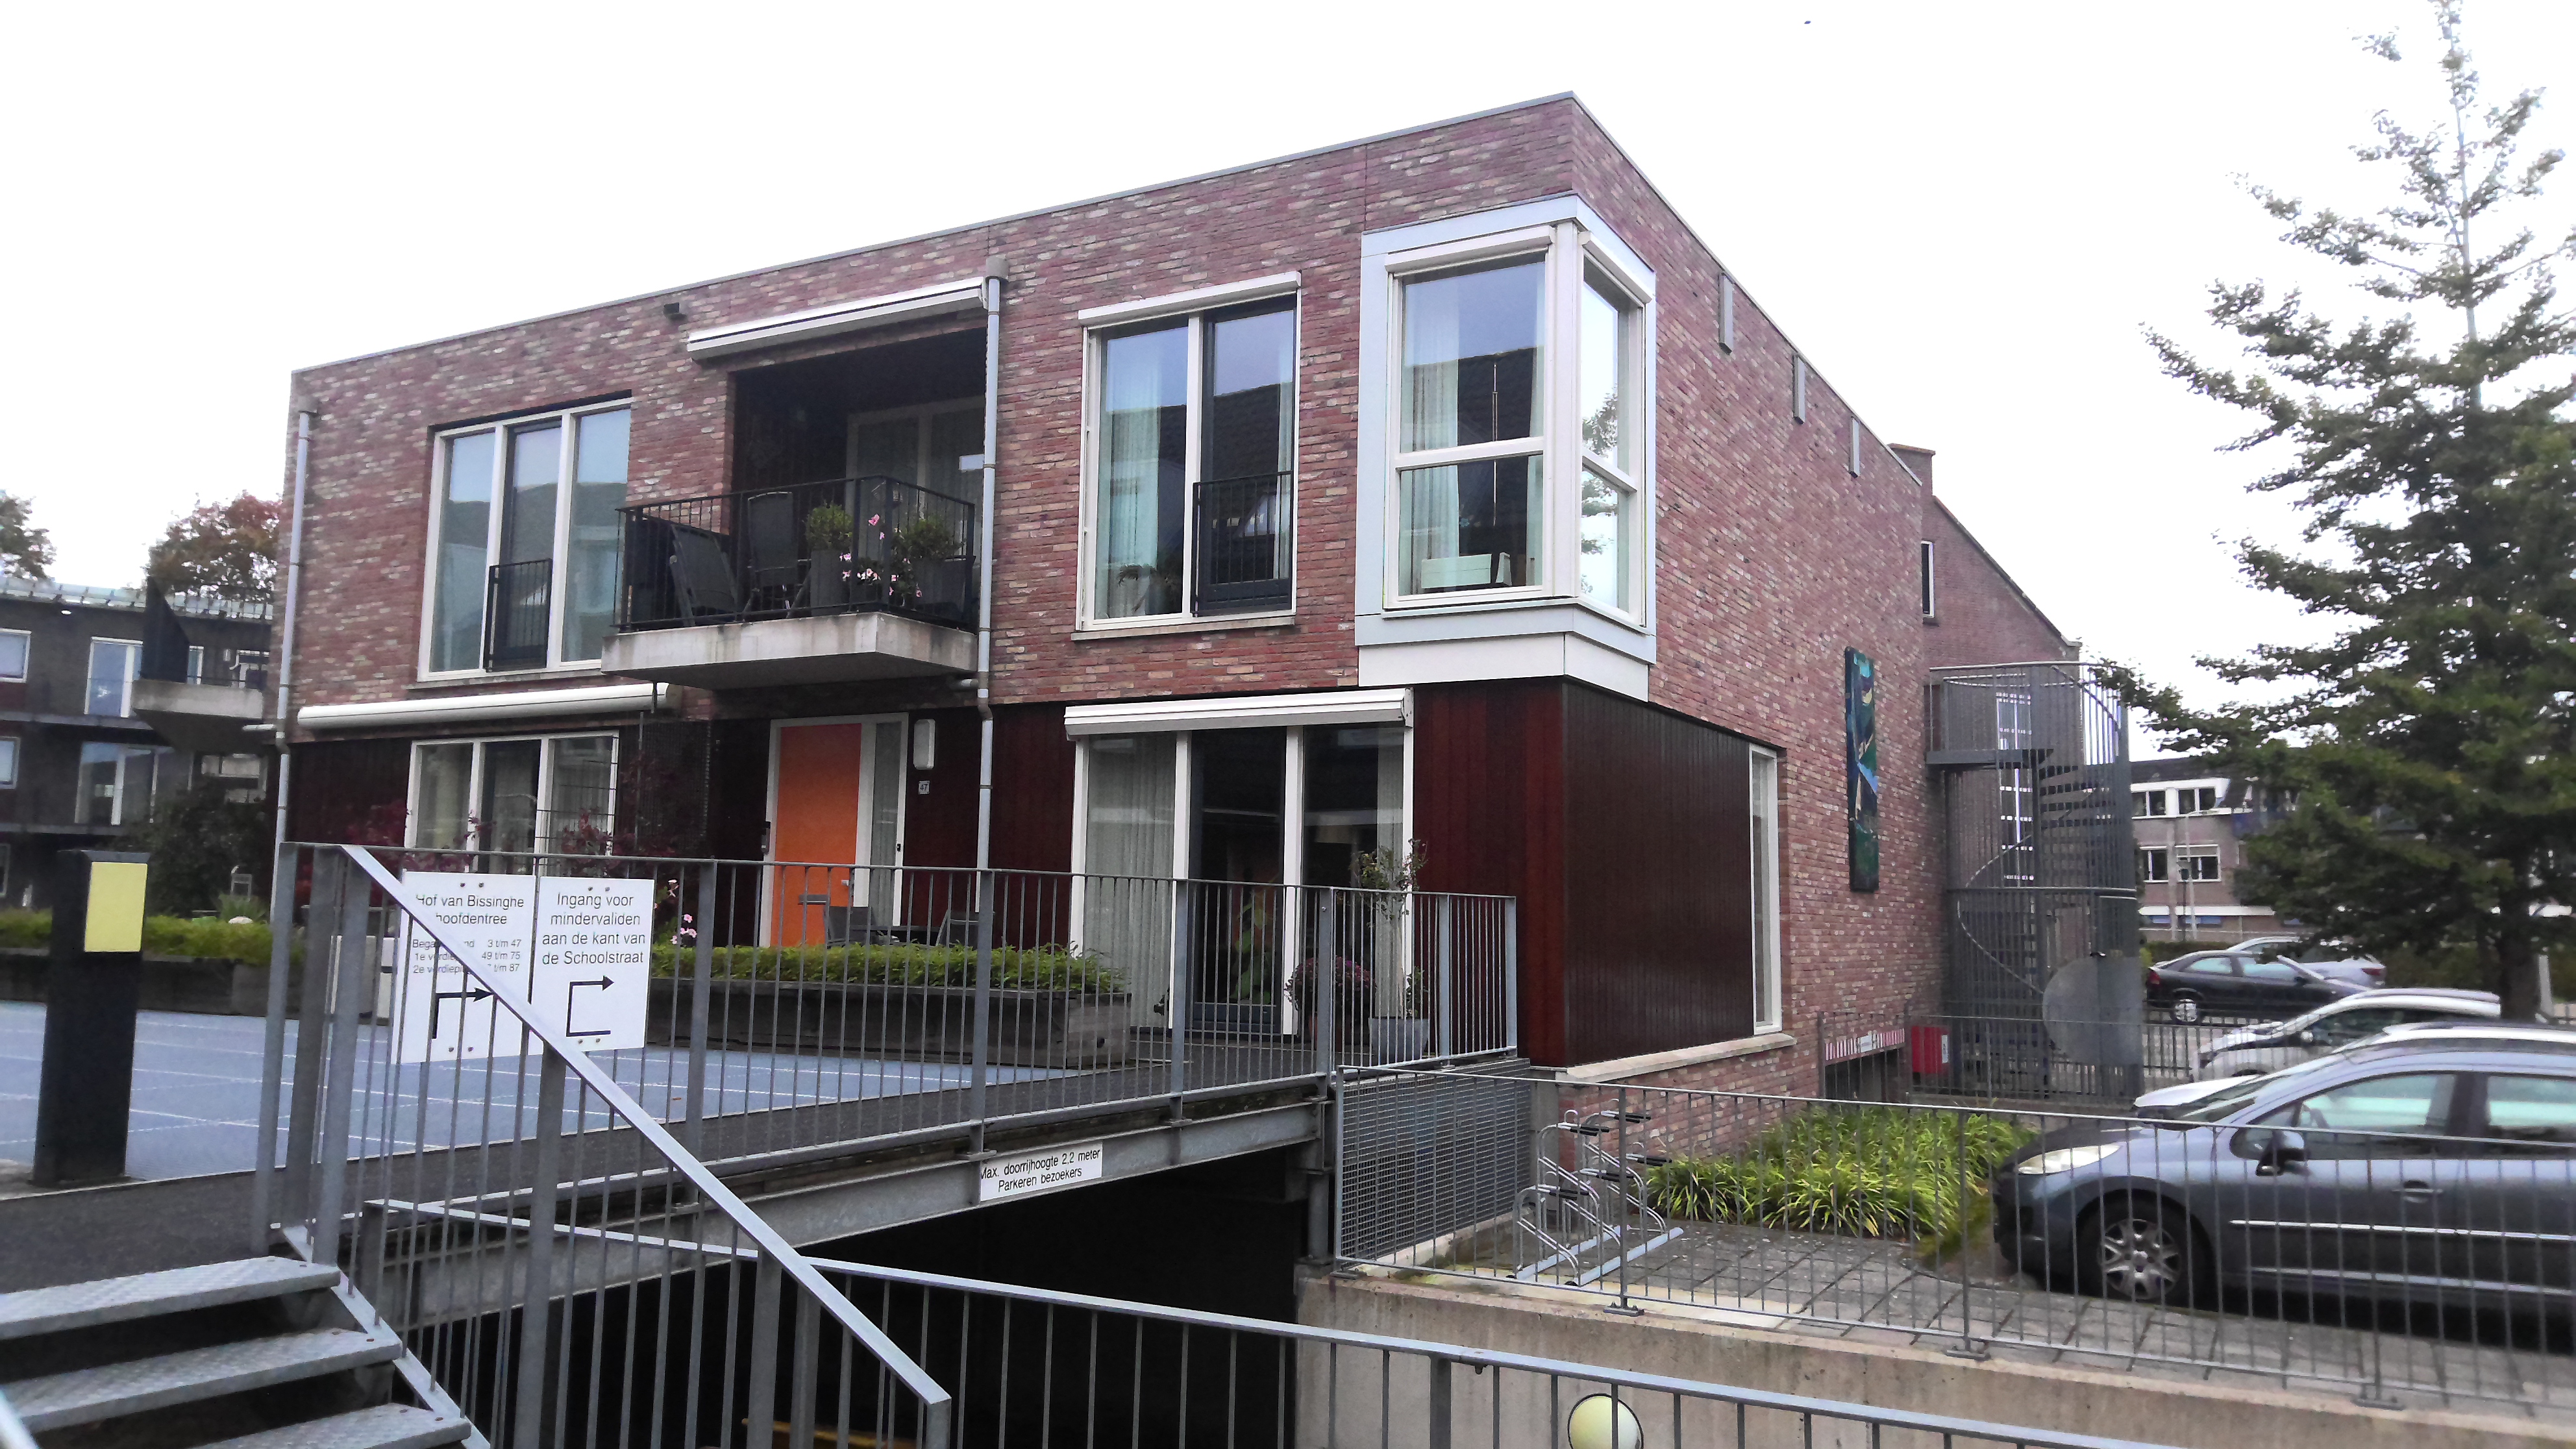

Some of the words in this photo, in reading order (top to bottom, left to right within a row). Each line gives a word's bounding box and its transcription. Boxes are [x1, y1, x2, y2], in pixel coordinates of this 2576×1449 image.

[441, 897, 463, 907] van
[467, 895, 525, 910] Bissinghe
[557, 892, 602, 909] Ingang
[606, 895, 634, 906] voor
[550, 911, 641, 925] mindervaliden
[488, 939, 493, 948] 3
[495, 939, 508, 948] t/m
[511, 939, 521, 948] 47
[542, 934, 567, 945] aan
[572, 932, 588, 945] de
[593, 932, 620, 945] kant
[624, 934, 645, 944] van
[415, 952, 425, 961] 1e
[482, 952, 492, 960] 49
[495, 951, 508, 960] t/m
[542, 951, 559, 965] de
[564, 950, 643, 965] Schoolstraat
[413, 965, 424, 974] 2e
[494, 963, 507, 972] t/m
[509, 963, 520, 972] 87
[1004, 1157, 1059, 1176] doorrijhoogte
[1078, 1148, 1100, 1162] meter
[998, 1176, 1037, 1193] Parkeren
[1041, 1167, 1082, 1184] bezoekers
